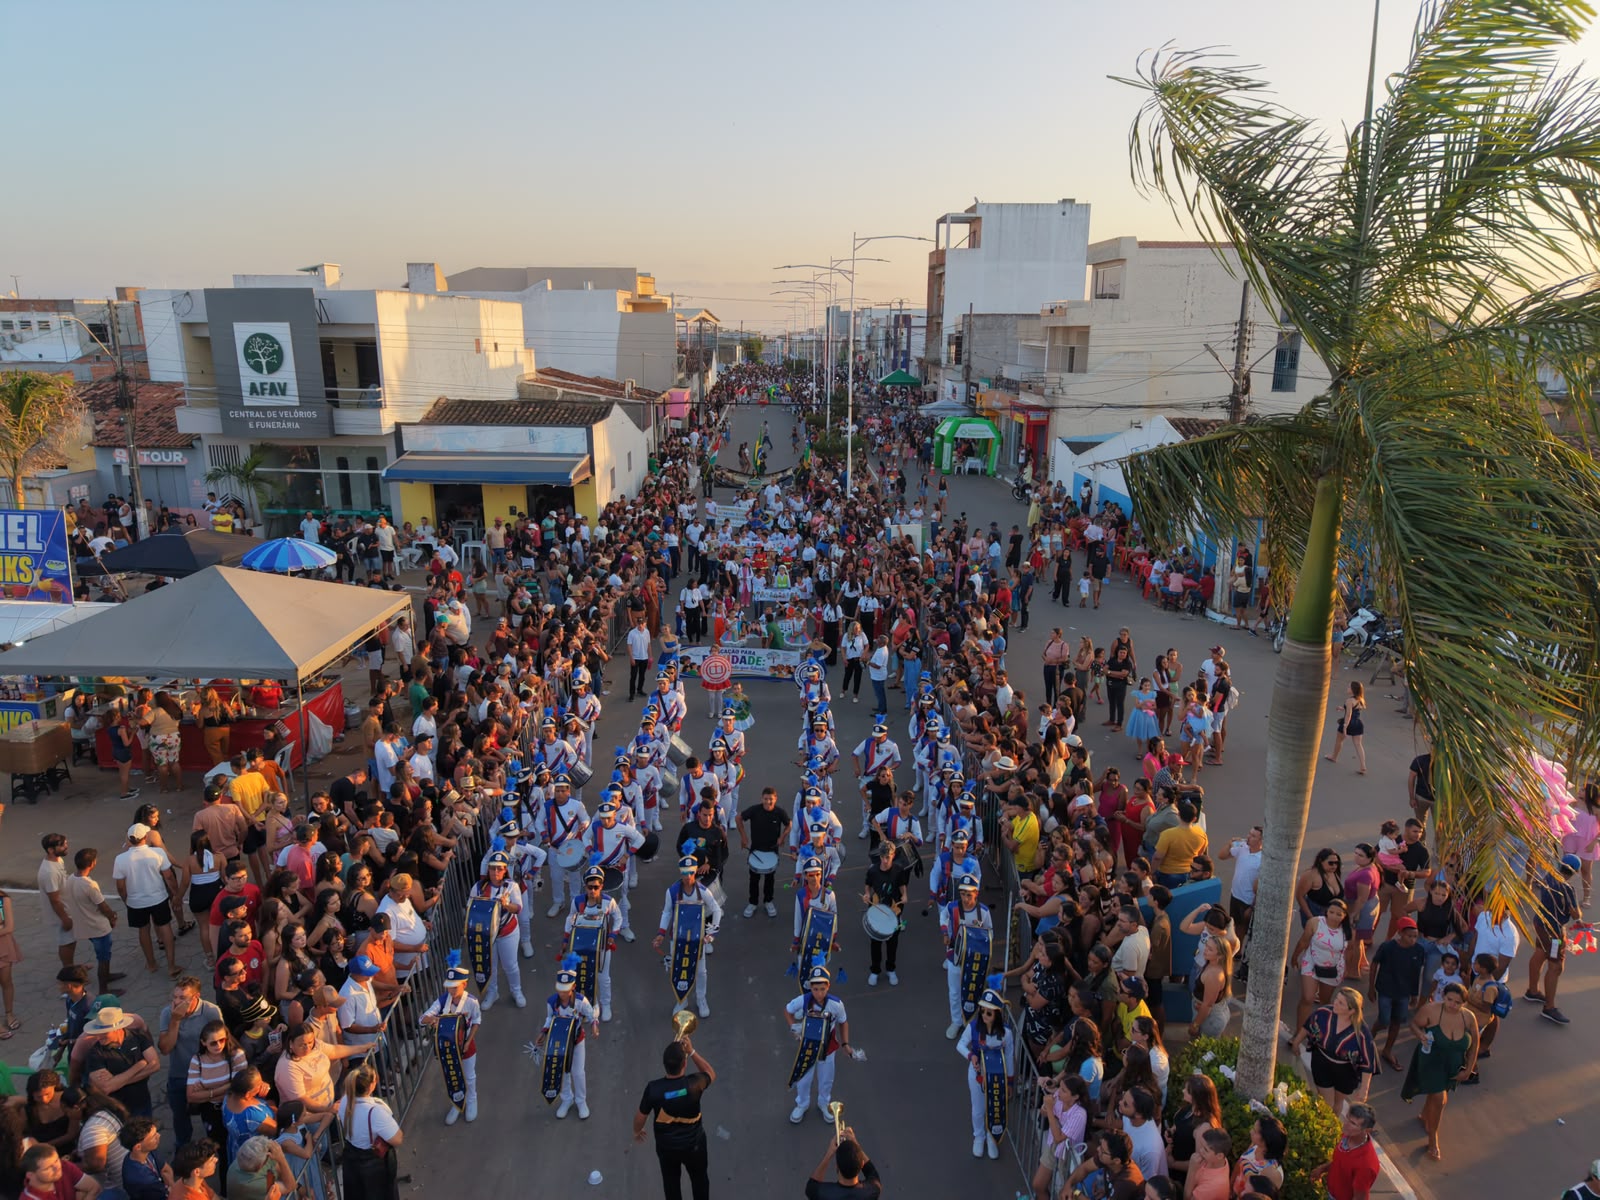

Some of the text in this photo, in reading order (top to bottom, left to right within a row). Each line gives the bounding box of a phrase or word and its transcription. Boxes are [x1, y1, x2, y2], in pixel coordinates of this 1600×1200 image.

[249, 382, 288, 397] AFAV
[229, 409, 317, 418] CENTRAL DE VELÓRIOS
[249, 420, 300, 429] E FUNERÁRIA
[140, 451, 183, 462] TOUR
[475, 922, 483, 972] BANDA
[680, 929, 691, 980] ILDA
[967, 952, 981, 1001] DUTRA
